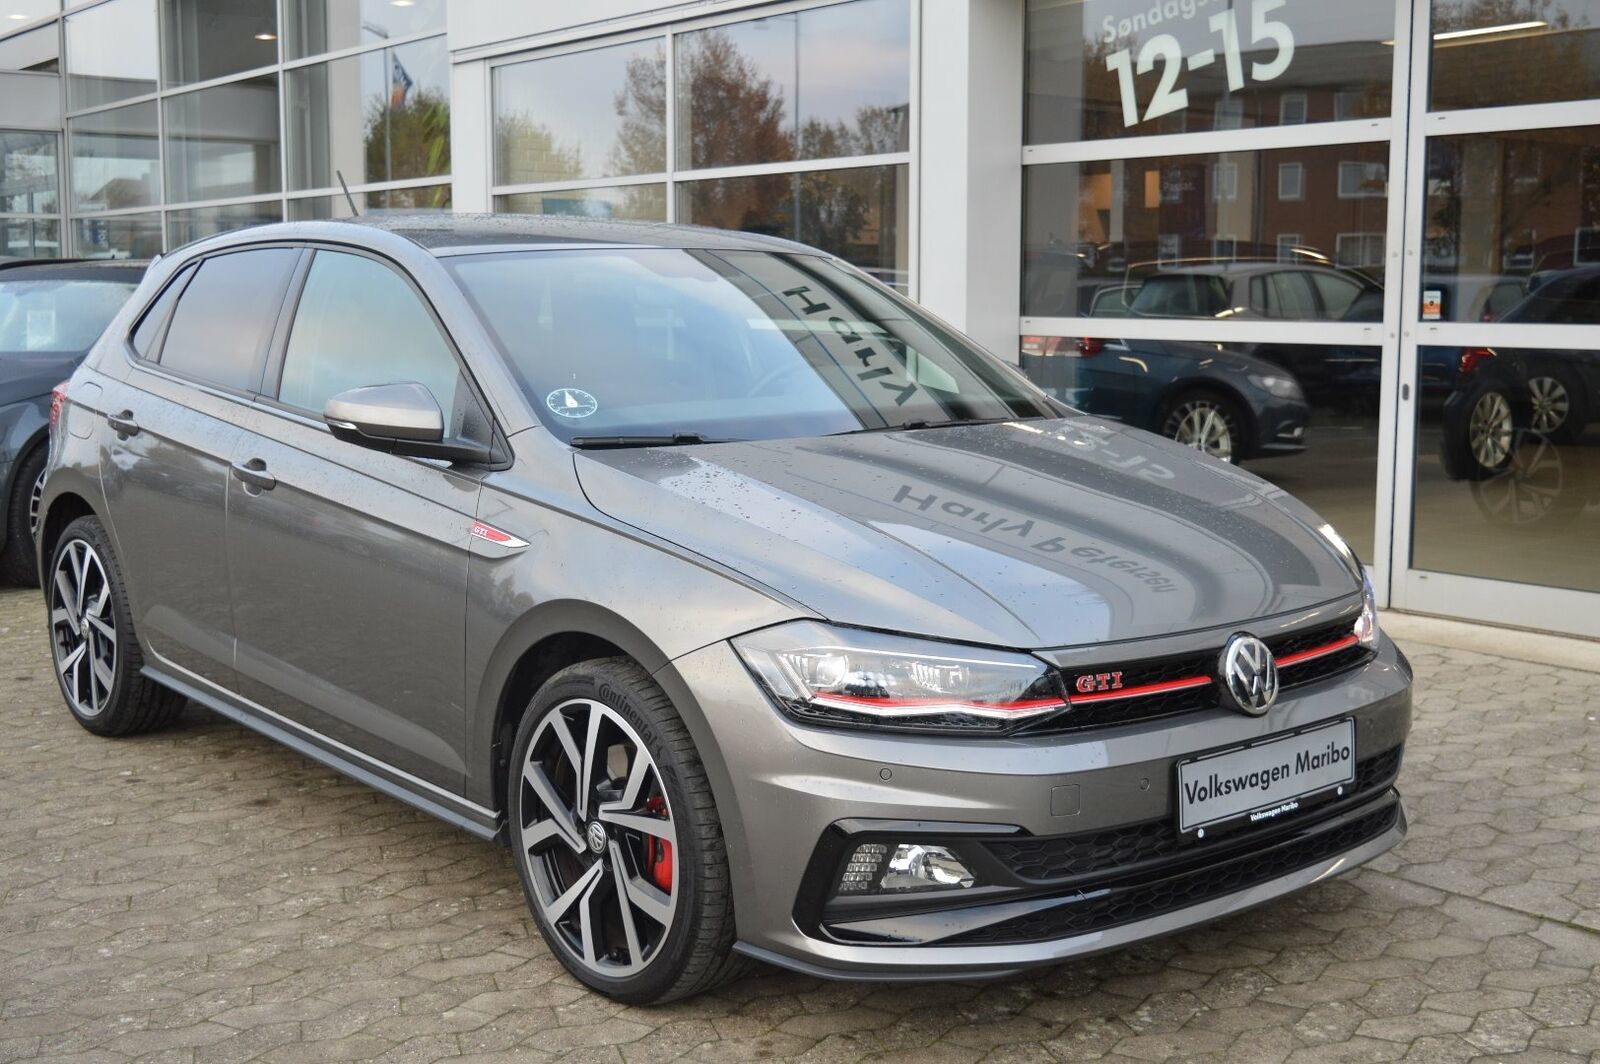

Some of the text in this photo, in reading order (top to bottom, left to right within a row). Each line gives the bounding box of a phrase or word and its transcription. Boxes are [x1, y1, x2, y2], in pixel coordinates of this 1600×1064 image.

[1102, 0, 1208, 43] Søndag
[1106, 0, 1295, 127] 12-15
[474, 526, 488, 536] GTI
[1076, 671, 1123, 693] GTI
[1184, 742, 1350, 804] Volkswagen Maribo
[1250, 802, 1299, 821] Volkswagen Maribo
